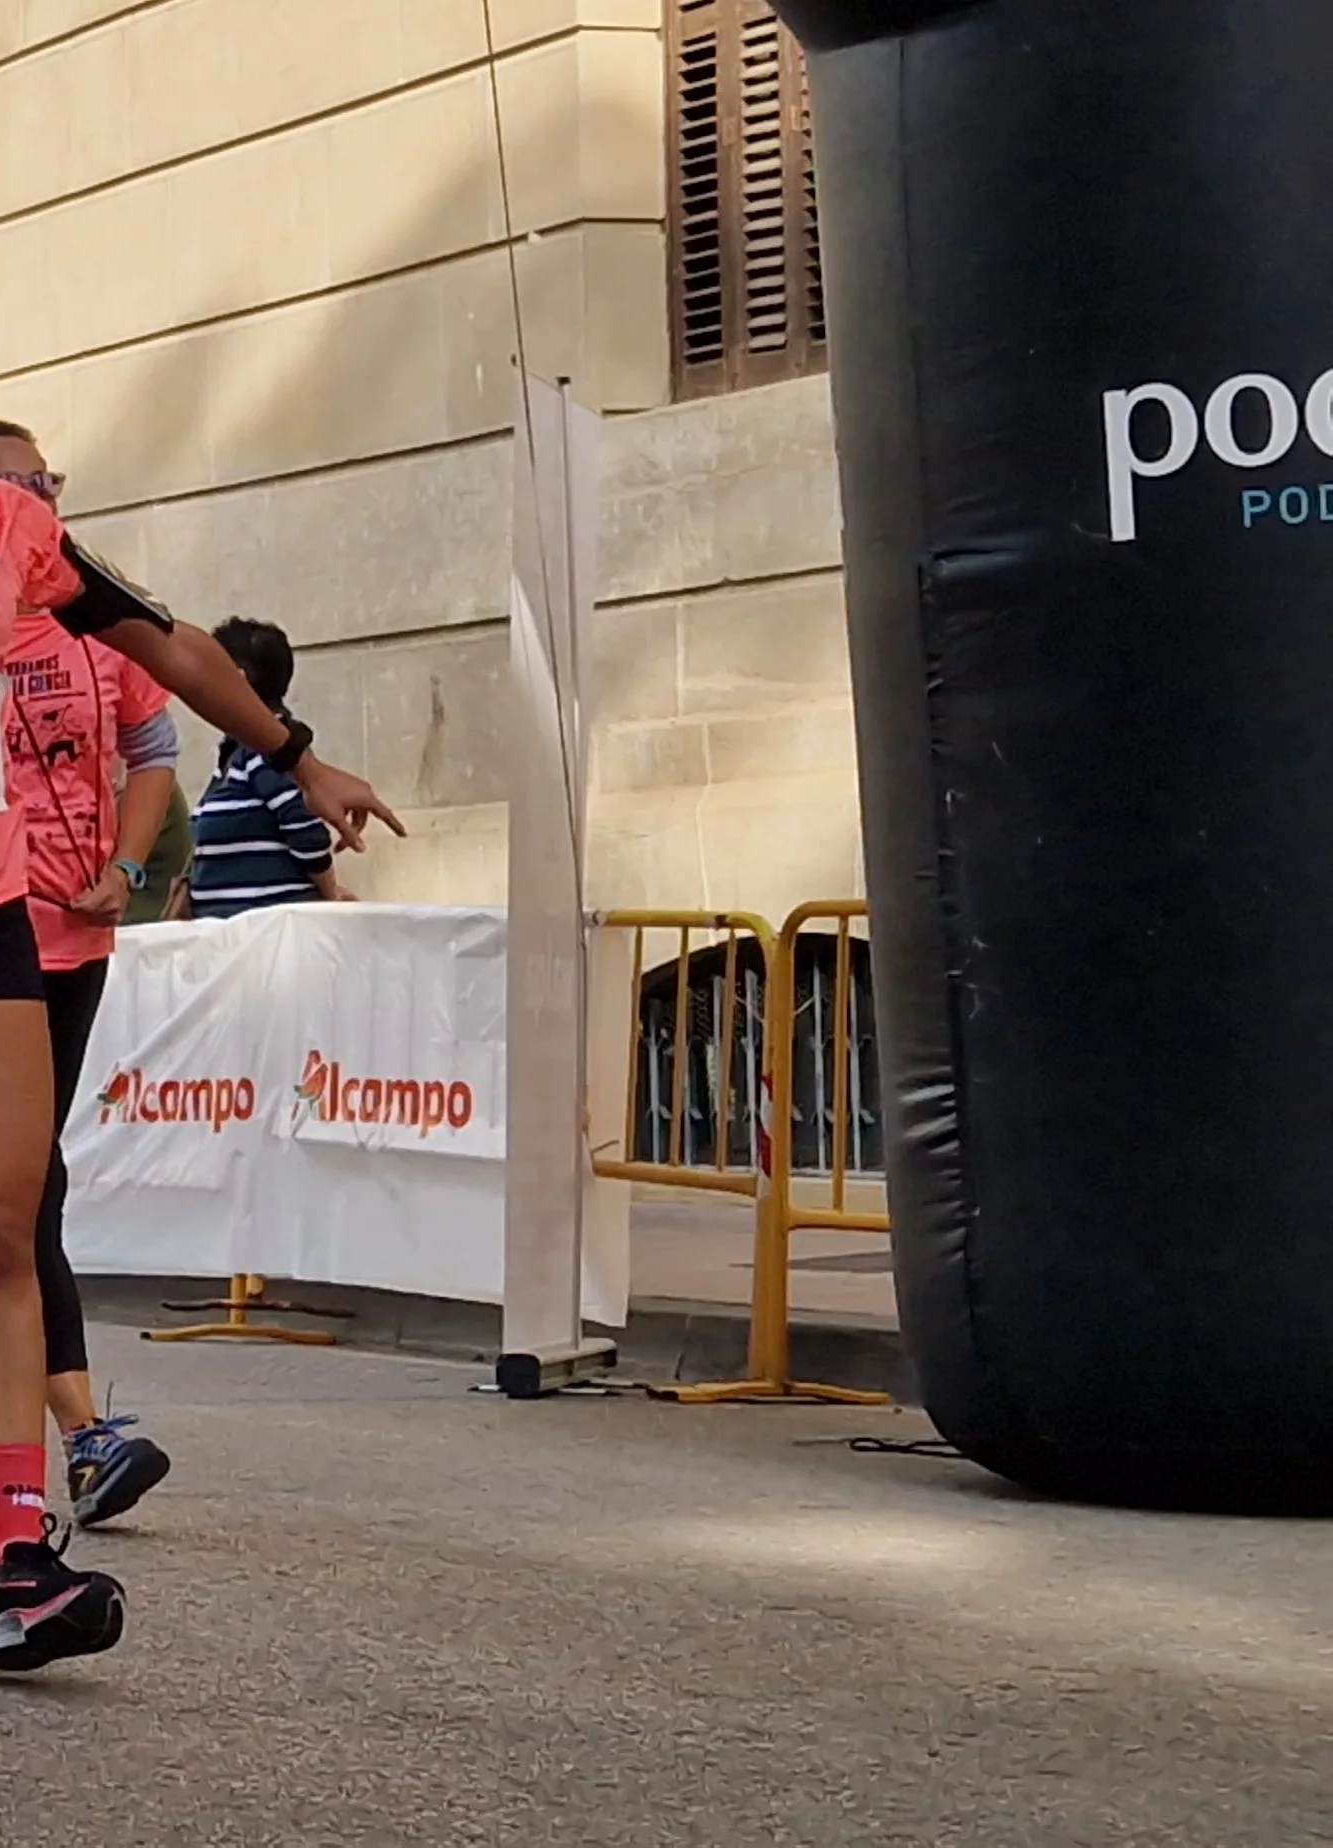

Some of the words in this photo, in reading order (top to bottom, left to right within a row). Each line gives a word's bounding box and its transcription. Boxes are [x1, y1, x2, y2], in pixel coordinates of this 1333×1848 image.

[1103, 364, 1333, 542] po
[98, 1063, 255, 1133] Alcampo
[291, 1050, 472, 1138] Alcampo
